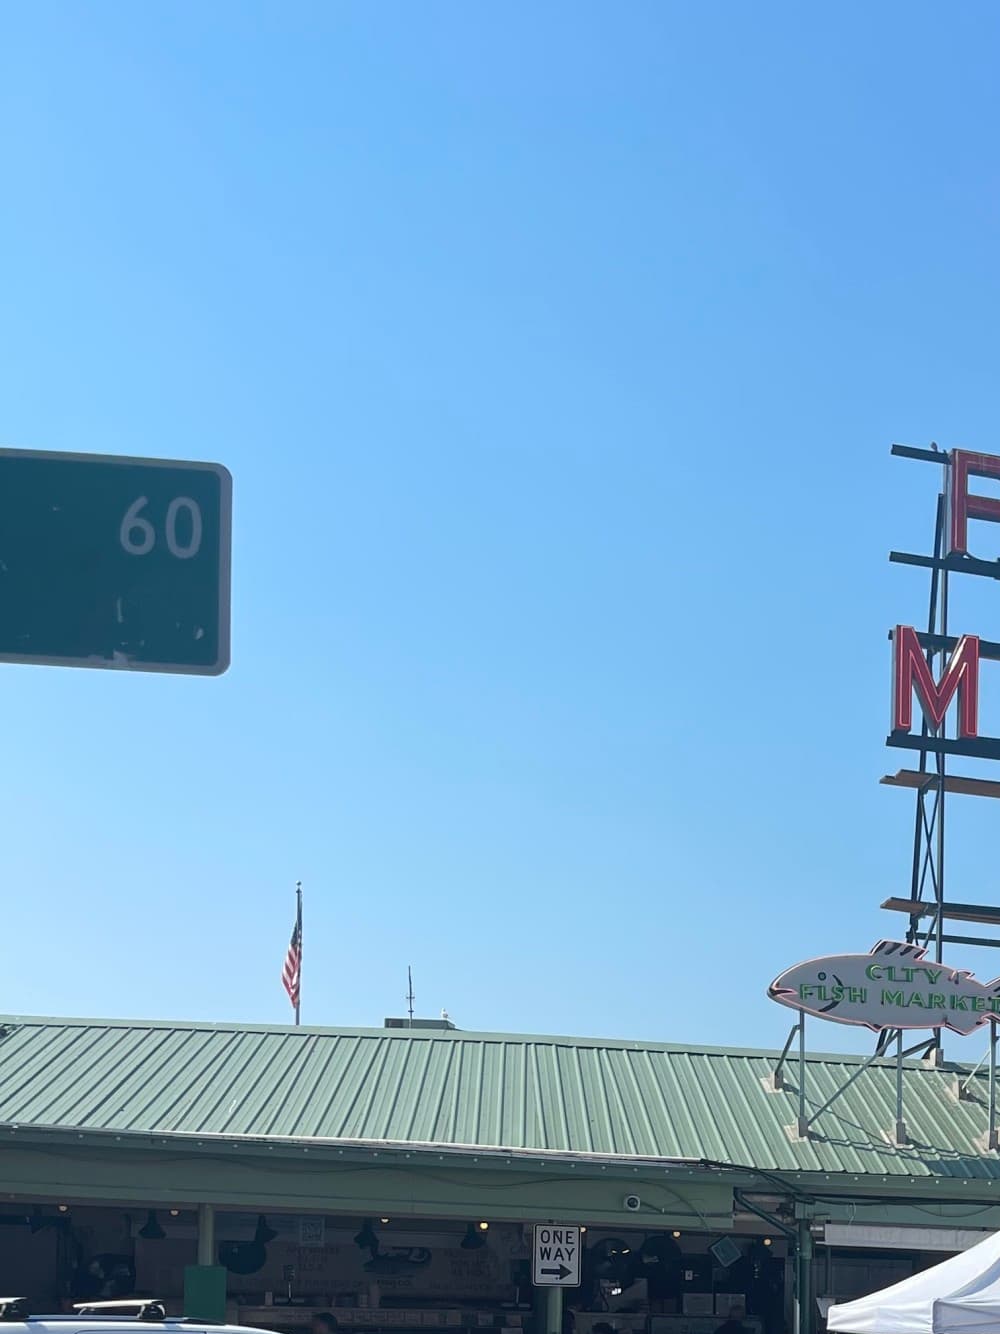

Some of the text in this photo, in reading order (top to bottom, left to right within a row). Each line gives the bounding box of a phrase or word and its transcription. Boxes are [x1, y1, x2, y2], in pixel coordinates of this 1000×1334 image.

[120, 496, 203, 559] 60
[866, 964, 942, 984] CITY
[799, 983, 867, 1004] FISH
[540, 1229, 575, 1245] ONE
[540, 1246, 576, 1261] WAY
